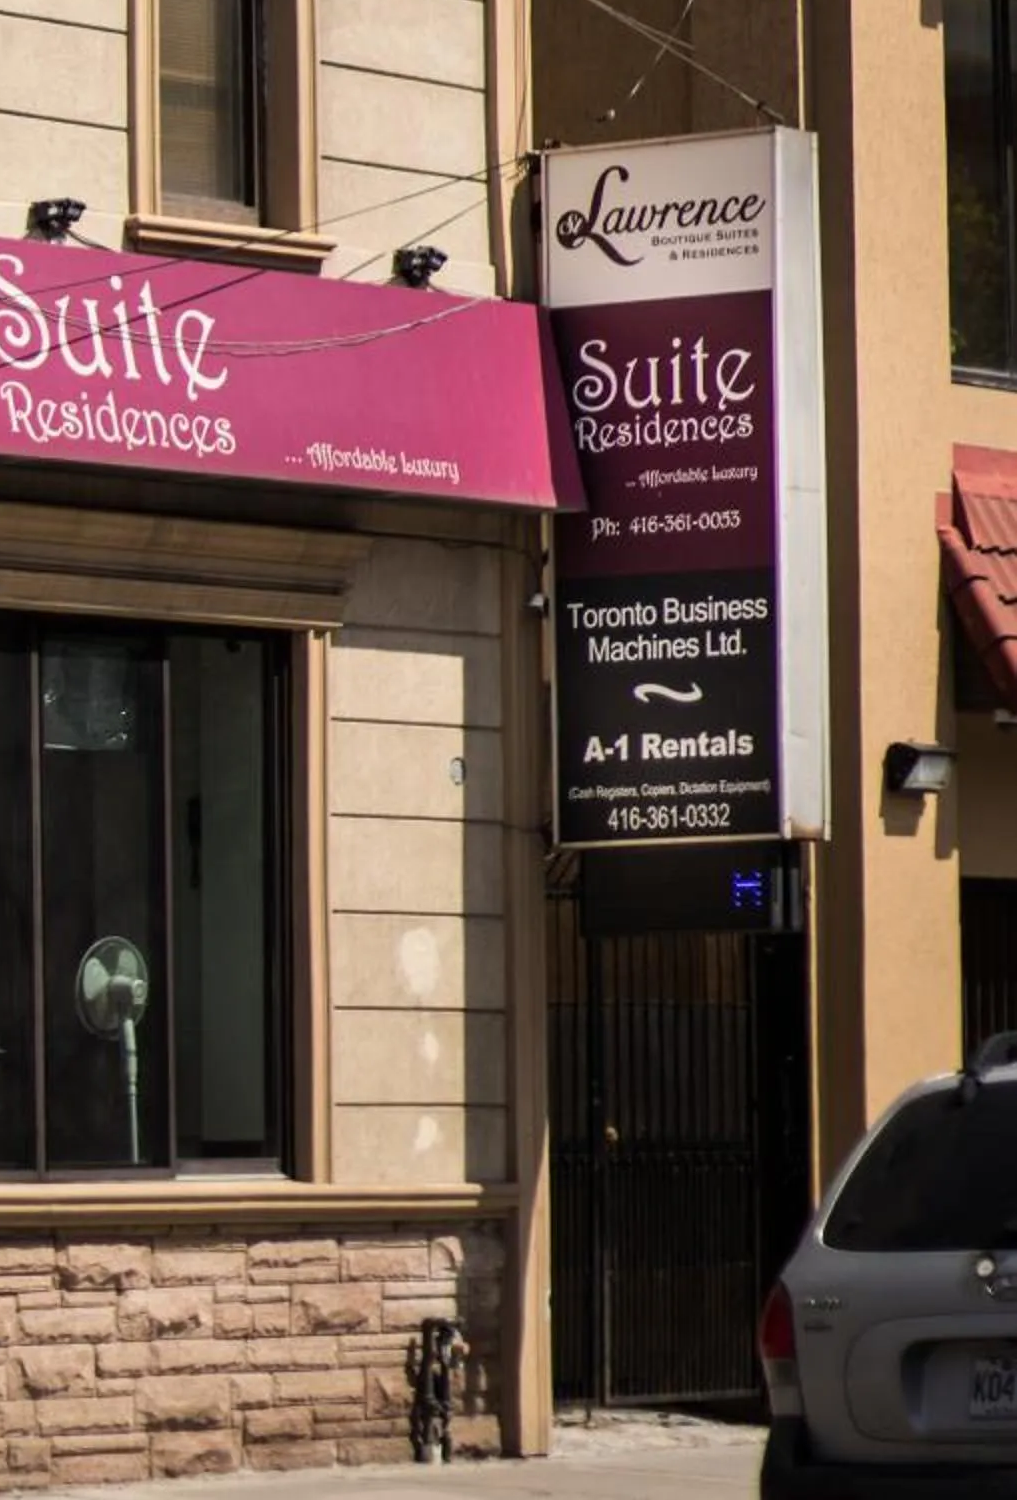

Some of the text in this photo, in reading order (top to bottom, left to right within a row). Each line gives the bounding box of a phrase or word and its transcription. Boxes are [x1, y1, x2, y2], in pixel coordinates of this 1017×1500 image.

[556, 165, 766, 266] Lawrence
[573, 336, 756, 412] Suite
[0, 381, 236, 458] Residences
[575, 411, 754, 453] Residences
[306, 443, 398, 474] Affordable
[638, 467, 708, 488] Affordable
[592, 517, 621, 541] Ph:
[567, 596, 768, 629] Toronto Business
[588, 628, 747, 663] Machines Ltd.
[583, 729, 754, 763] A-1 Rentals
[608, 803, 731, 831] 416-361-0332
